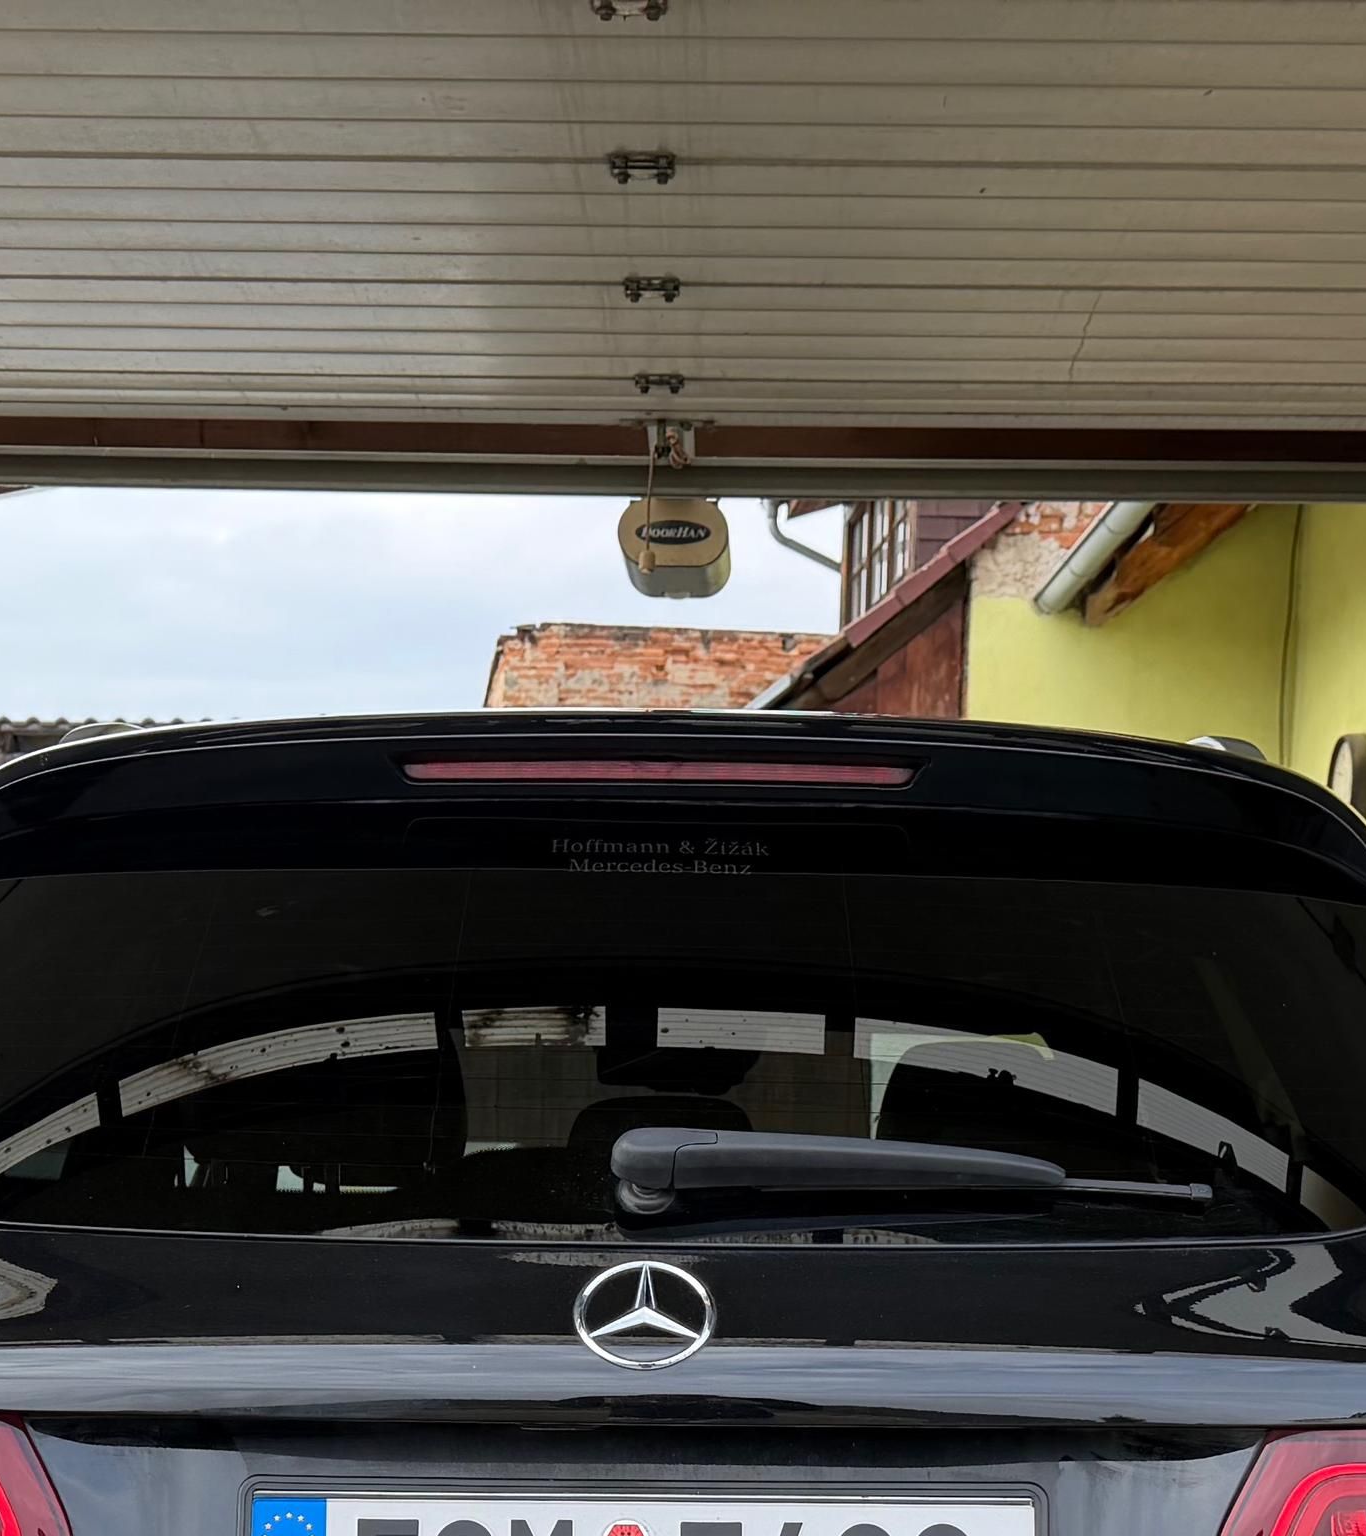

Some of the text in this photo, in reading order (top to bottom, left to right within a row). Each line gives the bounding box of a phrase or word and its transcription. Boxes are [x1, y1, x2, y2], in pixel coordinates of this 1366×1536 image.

[552, 838, 669, 854] Hoffmann
[679, 839, 695, 855] &
[569, 857, 753, 875] Mercedes-Benz
